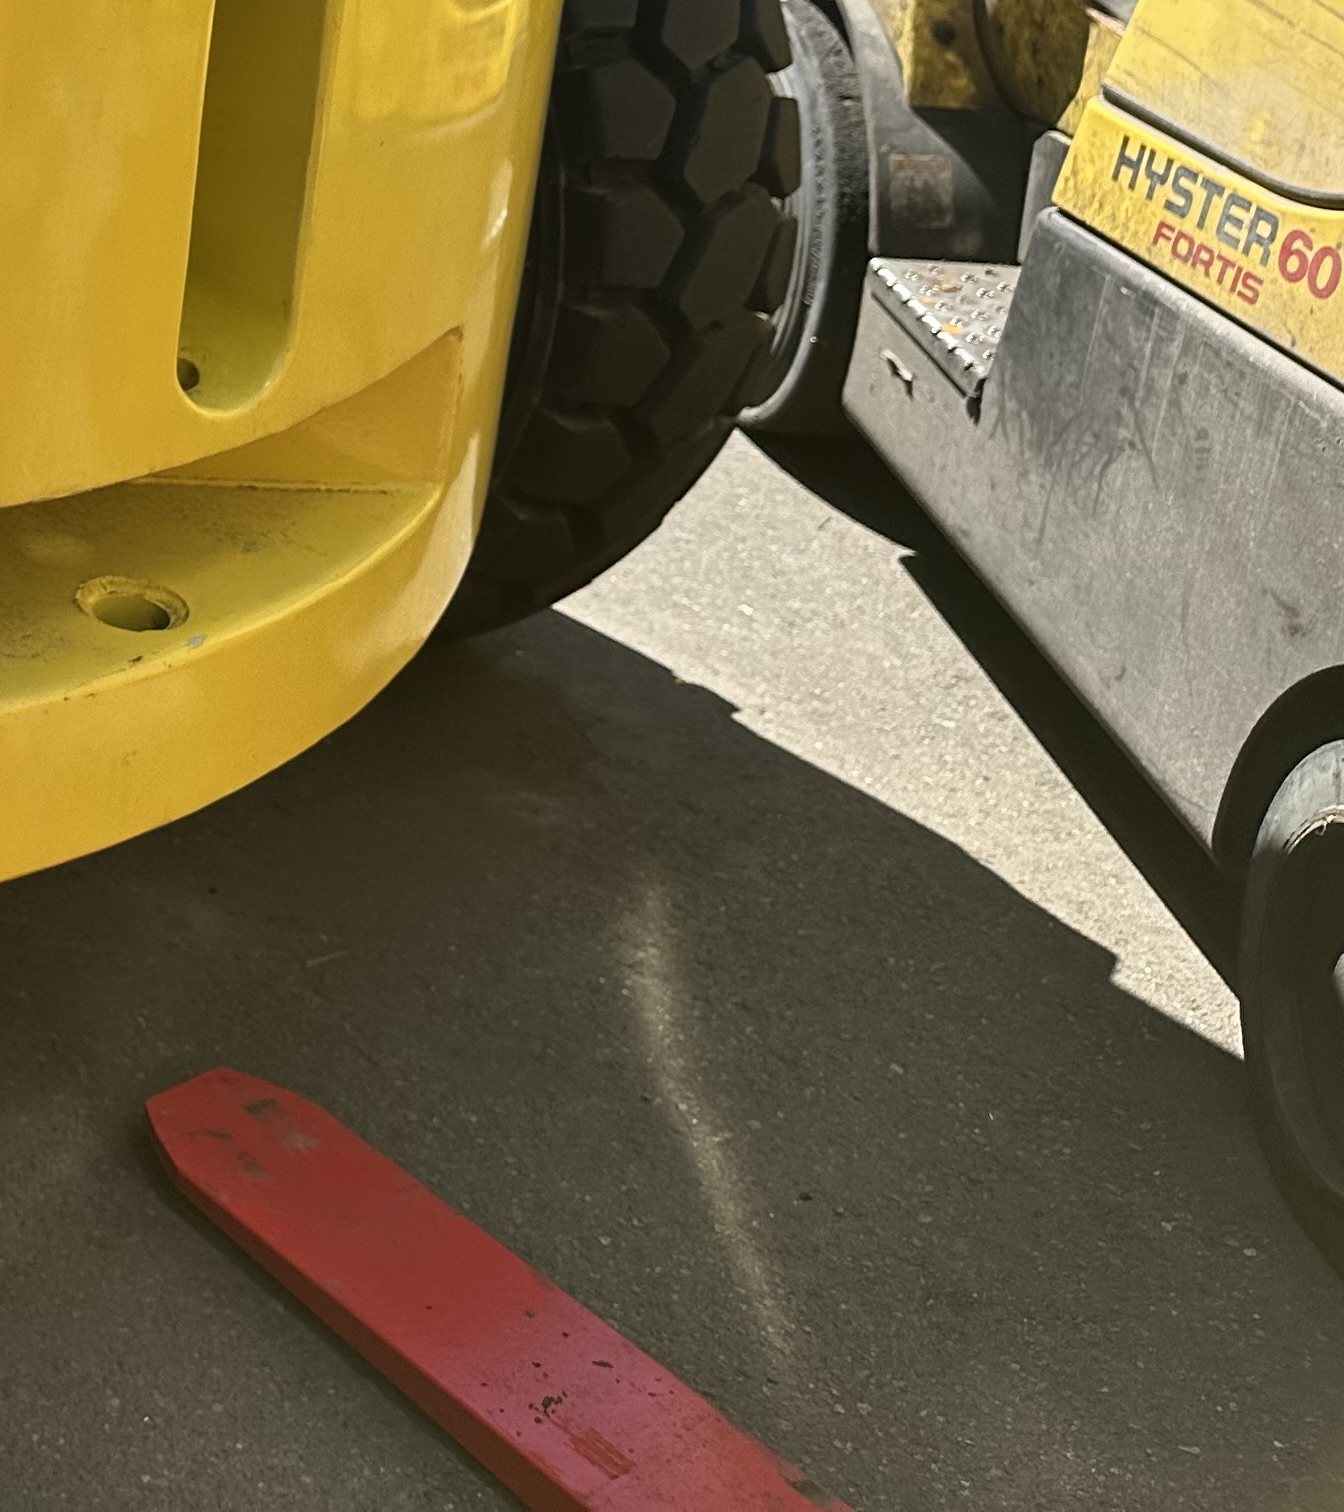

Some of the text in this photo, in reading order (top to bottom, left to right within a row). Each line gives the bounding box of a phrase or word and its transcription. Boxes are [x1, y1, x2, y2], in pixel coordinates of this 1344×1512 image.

[1112, 135, 1343, 301] HYSTER 60
[1152, 221, 1265, 306] FORTIS
